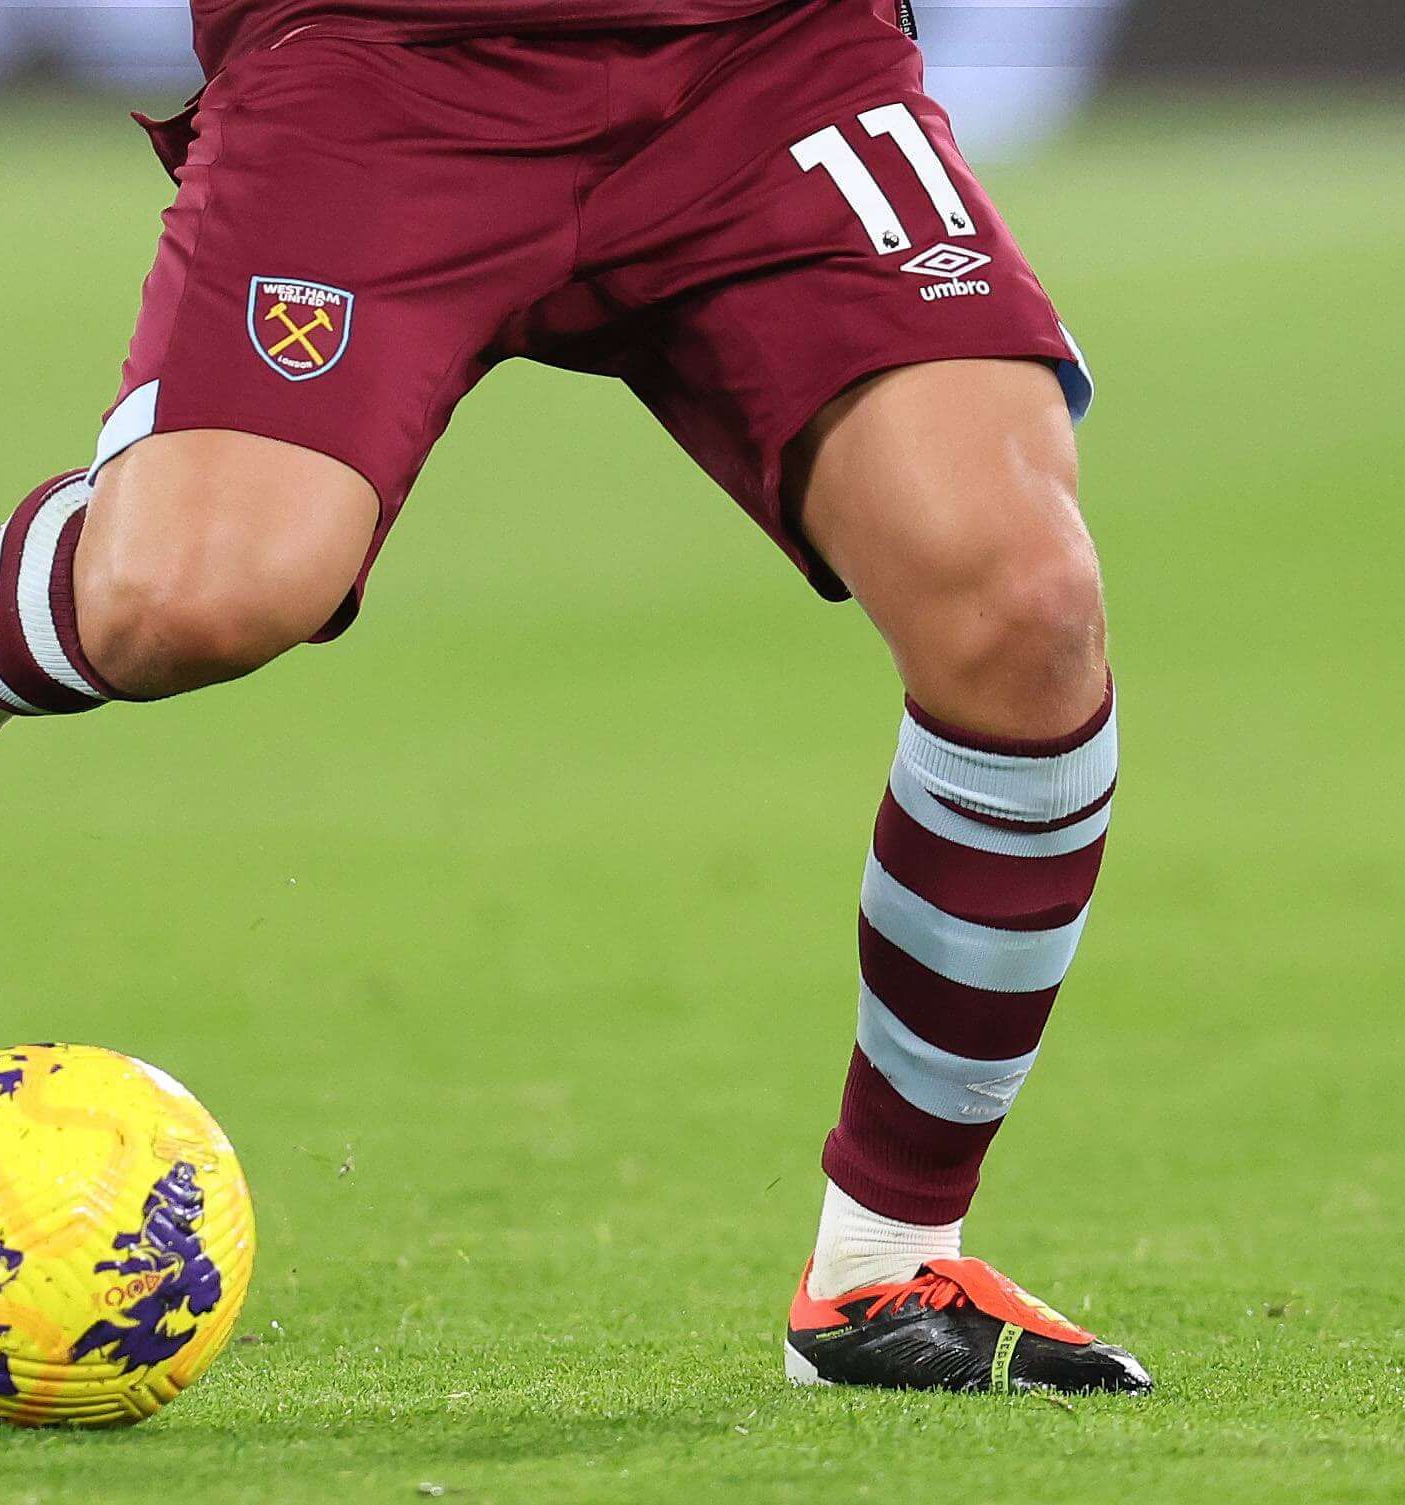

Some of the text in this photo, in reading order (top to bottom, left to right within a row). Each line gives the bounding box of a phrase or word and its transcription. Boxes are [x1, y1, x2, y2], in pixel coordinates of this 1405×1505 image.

[788, 101, 978, 256] 11
[262, 283, 341, 306] WEST HAM
[278, 293, 325, 307] UNITED
[919, 277, 990, 302] umbro
[277, 355, 313, 369] LONDON
